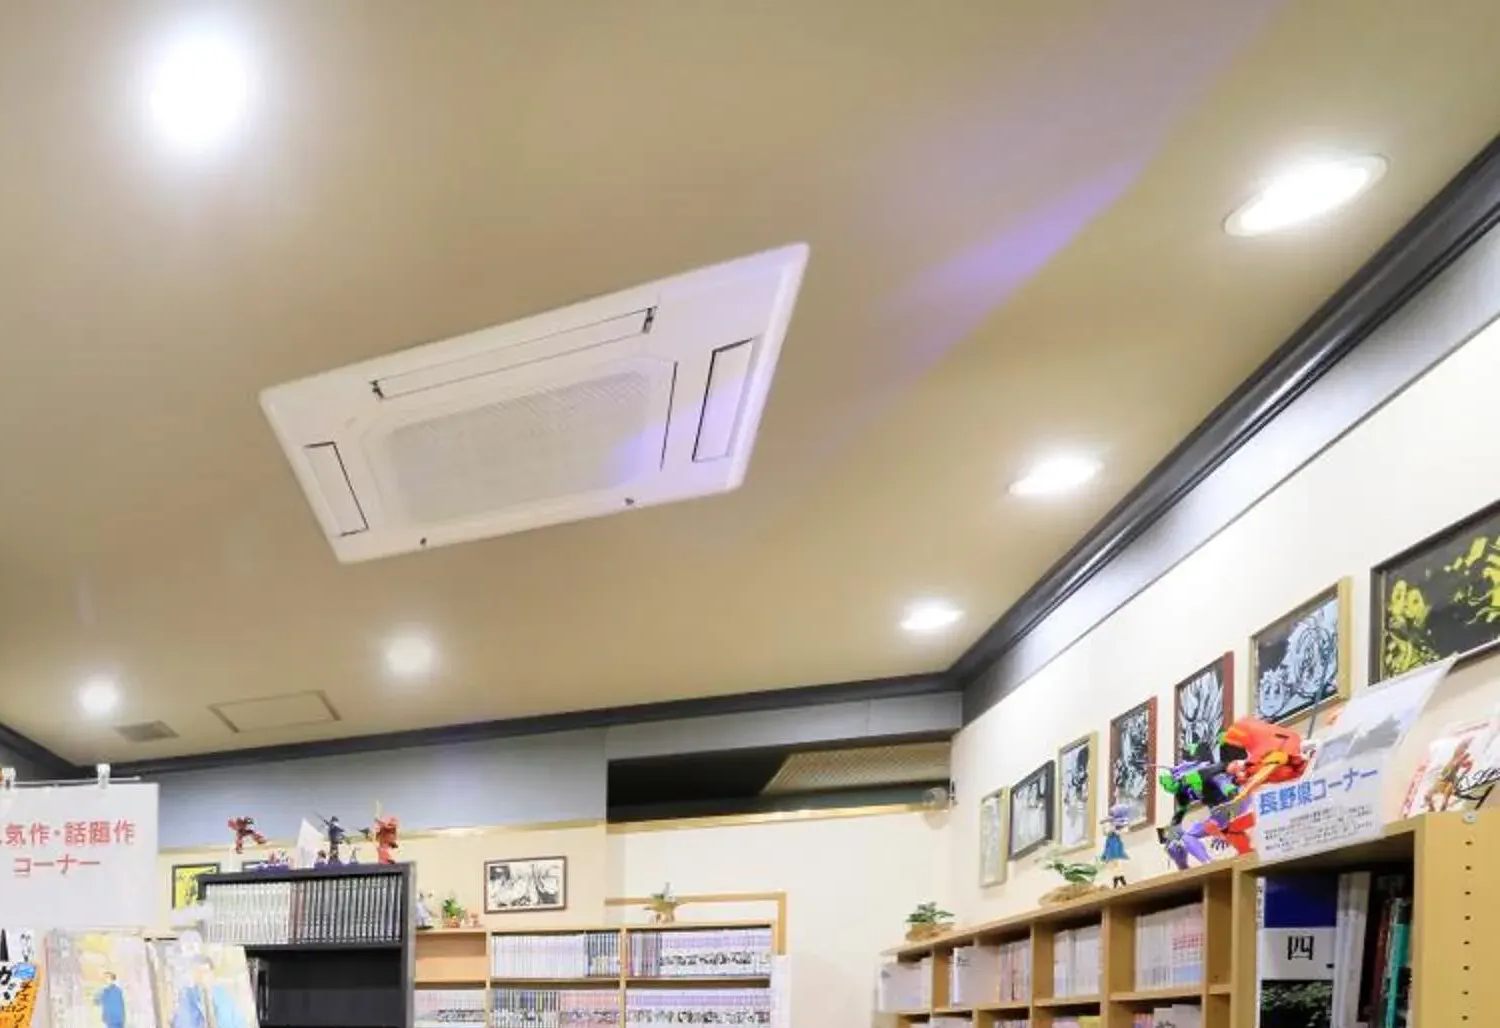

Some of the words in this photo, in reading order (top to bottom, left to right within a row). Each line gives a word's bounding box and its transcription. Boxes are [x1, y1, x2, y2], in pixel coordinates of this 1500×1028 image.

[1259, 767, 1378, 815] 長野県コーナー
[14, 854, 100, 876] コーナー
